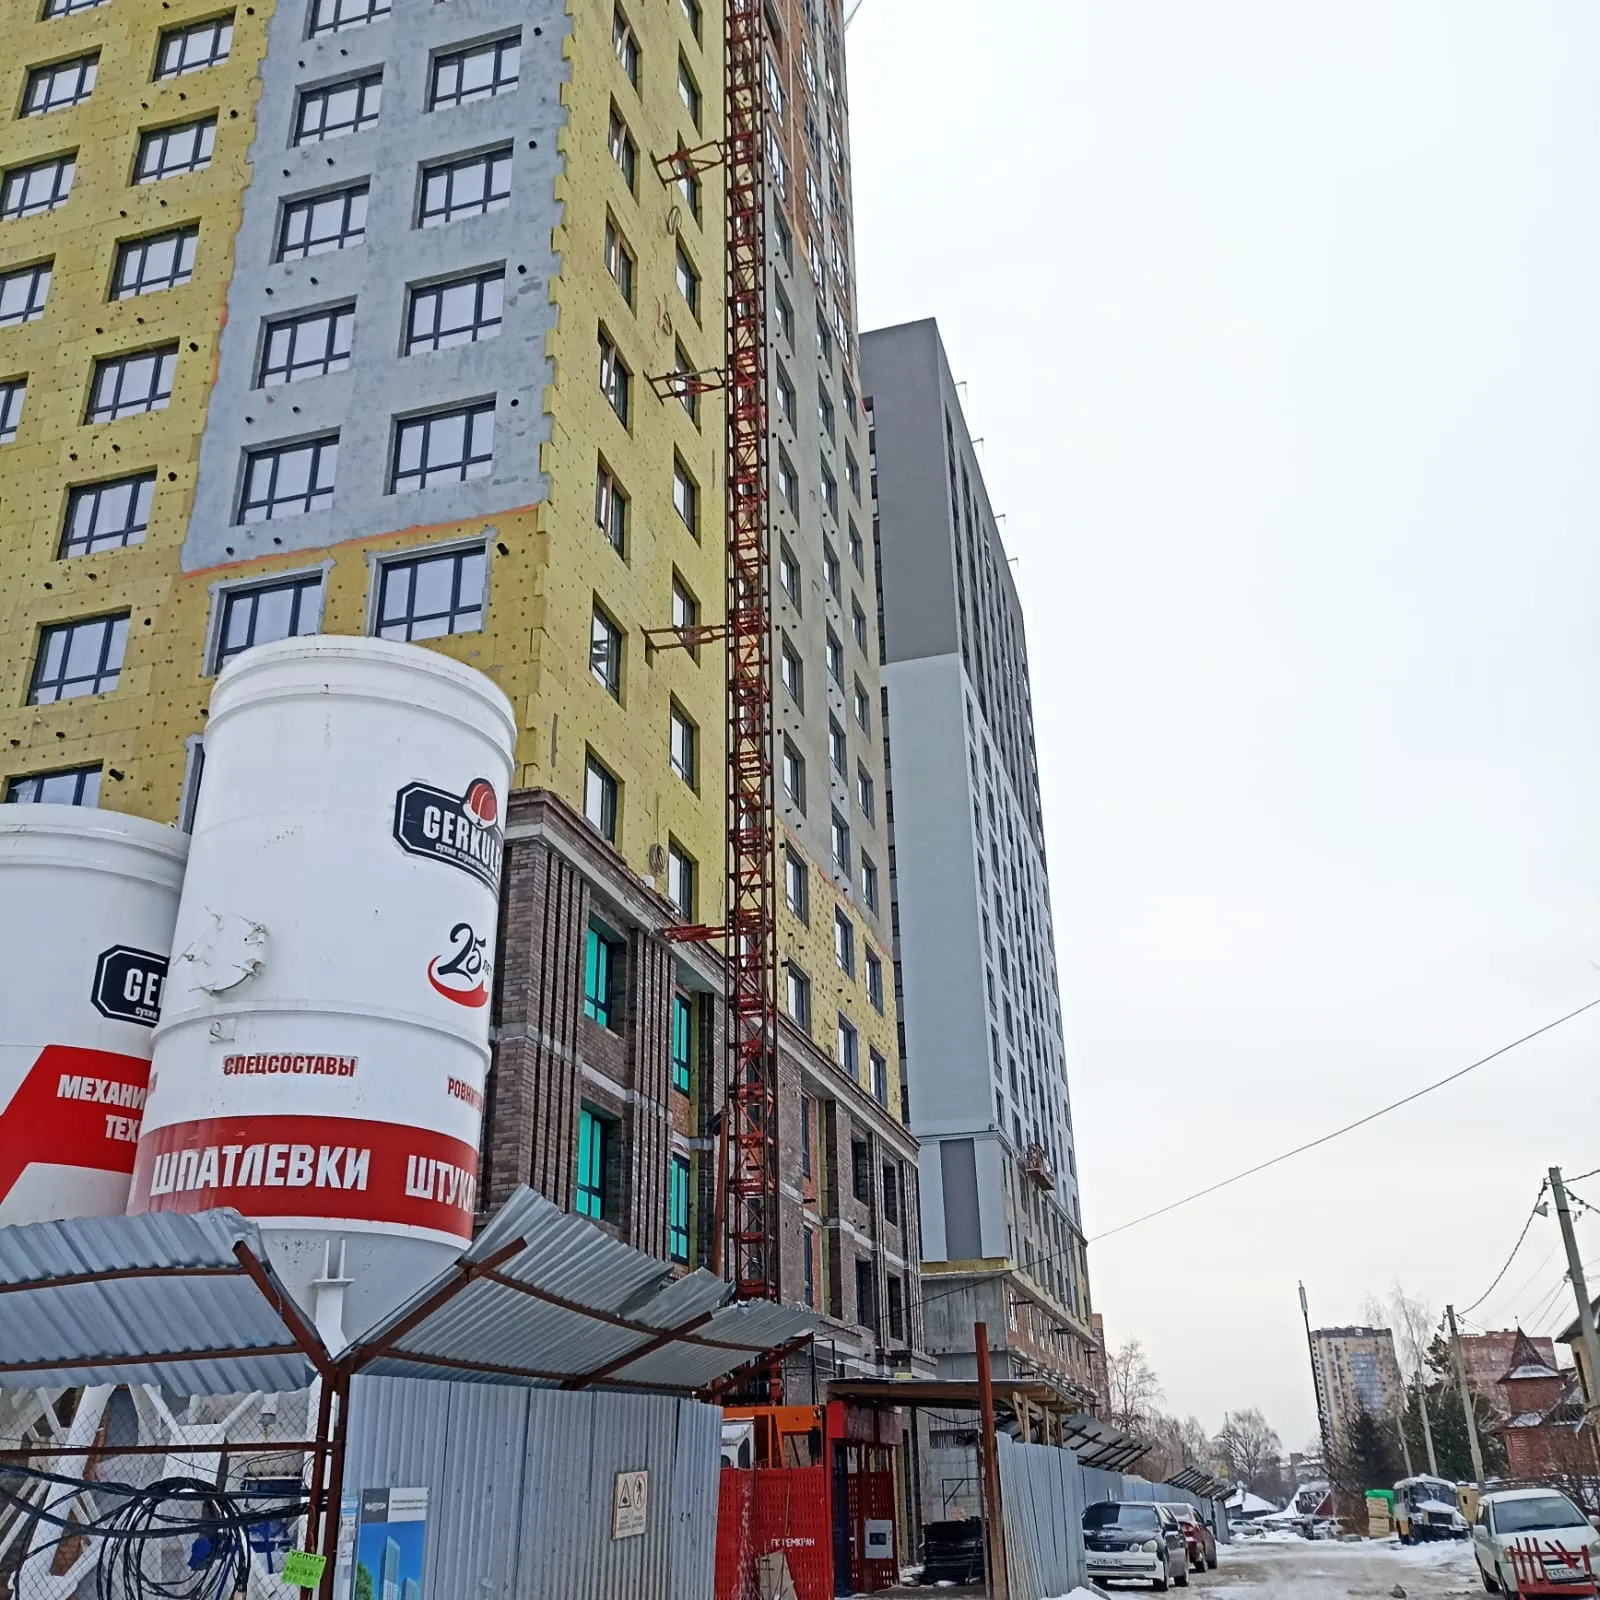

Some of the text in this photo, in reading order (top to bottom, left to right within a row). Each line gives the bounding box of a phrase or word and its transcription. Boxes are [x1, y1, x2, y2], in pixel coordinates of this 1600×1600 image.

[437, 922, 486, 983] 25
[223, 1055, 355, 1077] СПЕЦСОСТАВЫ
[150, 1144, 371, 1196] ШПАТЛЕВКИ
